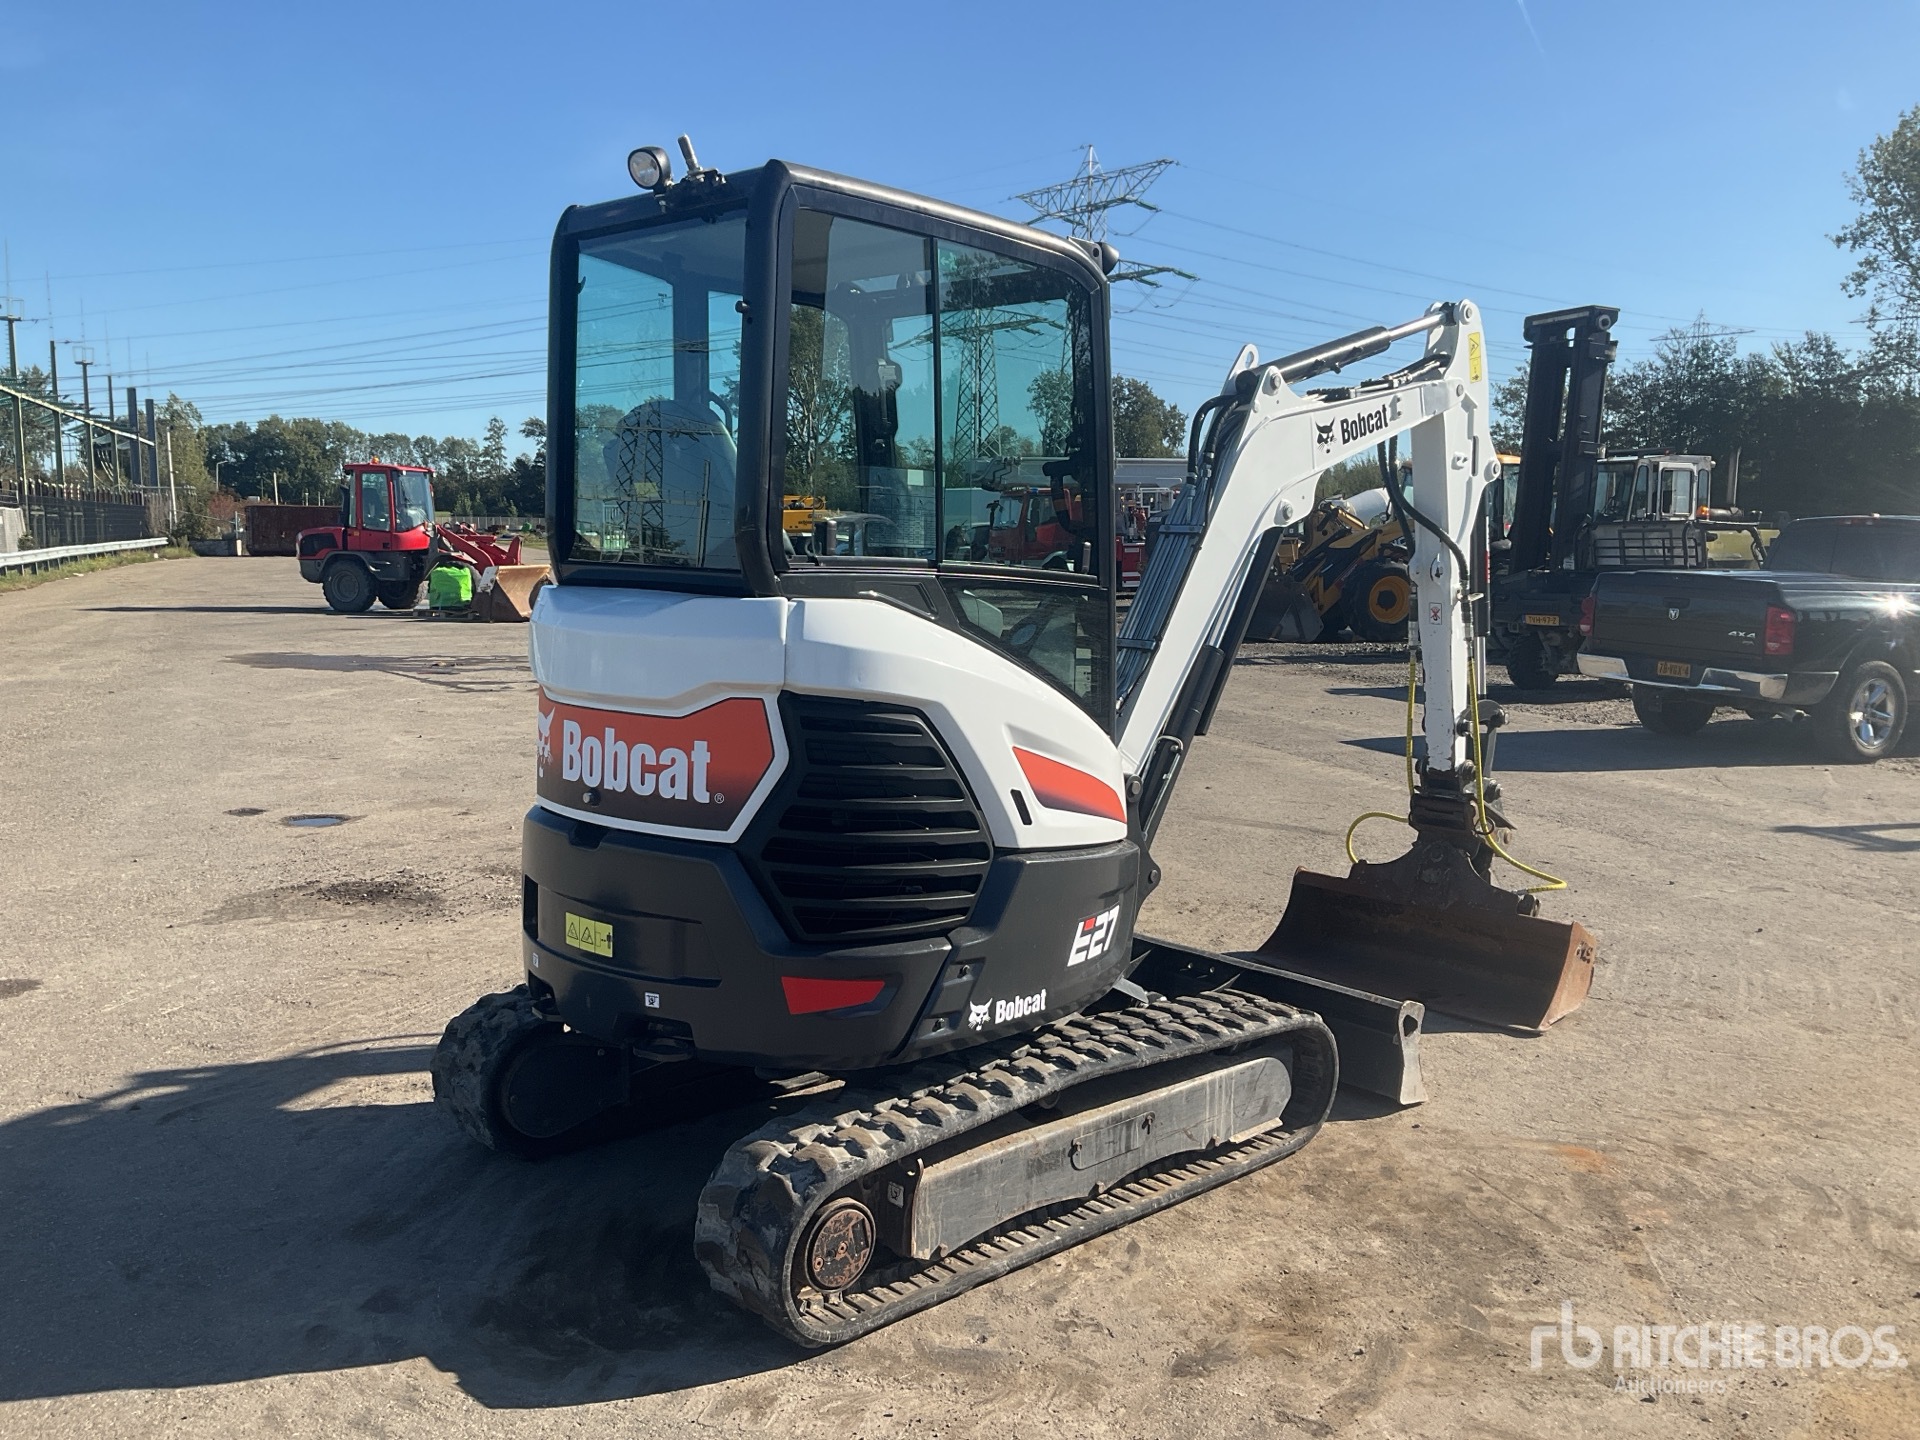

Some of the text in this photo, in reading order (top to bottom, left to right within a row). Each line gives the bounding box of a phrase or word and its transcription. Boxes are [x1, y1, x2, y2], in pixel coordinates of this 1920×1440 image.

[1340, 404, 1388, 445] Bobcat
[562, 719, 711, 804] Bobcat
[1067, 905, 1120, 967] E27
[995, 988, 1047, 1025] Bobcat
